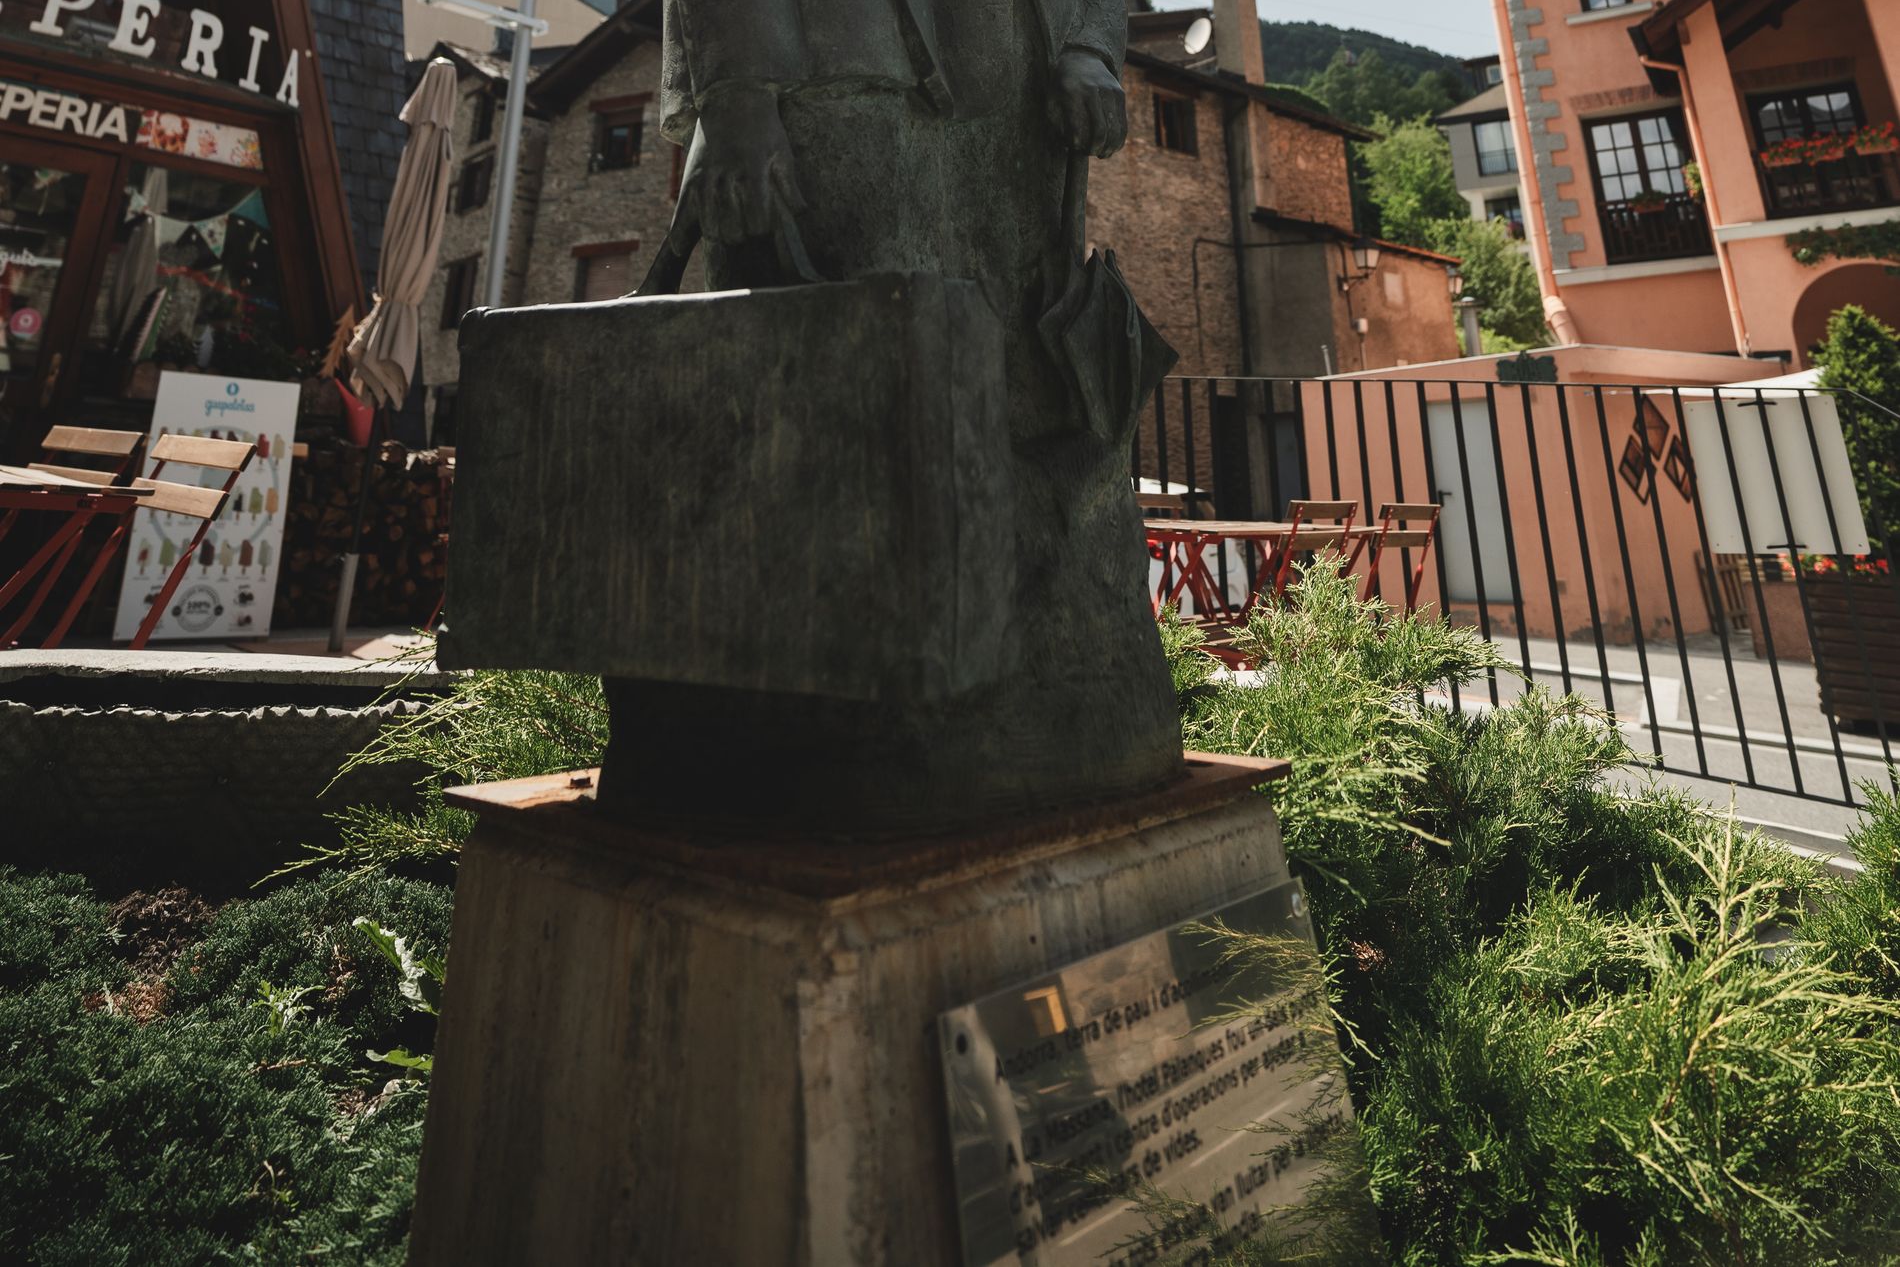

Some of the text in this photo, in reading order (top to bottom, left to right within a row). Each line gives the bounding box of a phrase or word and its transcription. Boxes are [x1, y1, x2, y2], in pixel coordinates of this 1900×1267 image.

[1063, 1019, 1100, 1053] terra
[1102, 1008, 1123, 1035] de
[1123, 997, 1149, 1030] pau
[1006, 1143, 1018, 1171] A
[1115, 1065, 1160, 1112] l'hotel
[1161, 1036, 1226, 1092] Palanques
[1224, 1026, 1247, 1053] fou
[1113, 1113, 1160, 1156] centre
[1161, 1068, 1240, 1130] d'operacions
[1239, 1056, 1259, 1088] per
[1140, 1143, 1162, 1179] de
[1162, 1125, 1203, 1166] vides.
[1210, 1184, 1236, 1215] van
[1233, 1158, 1272, 1201] lluitar
